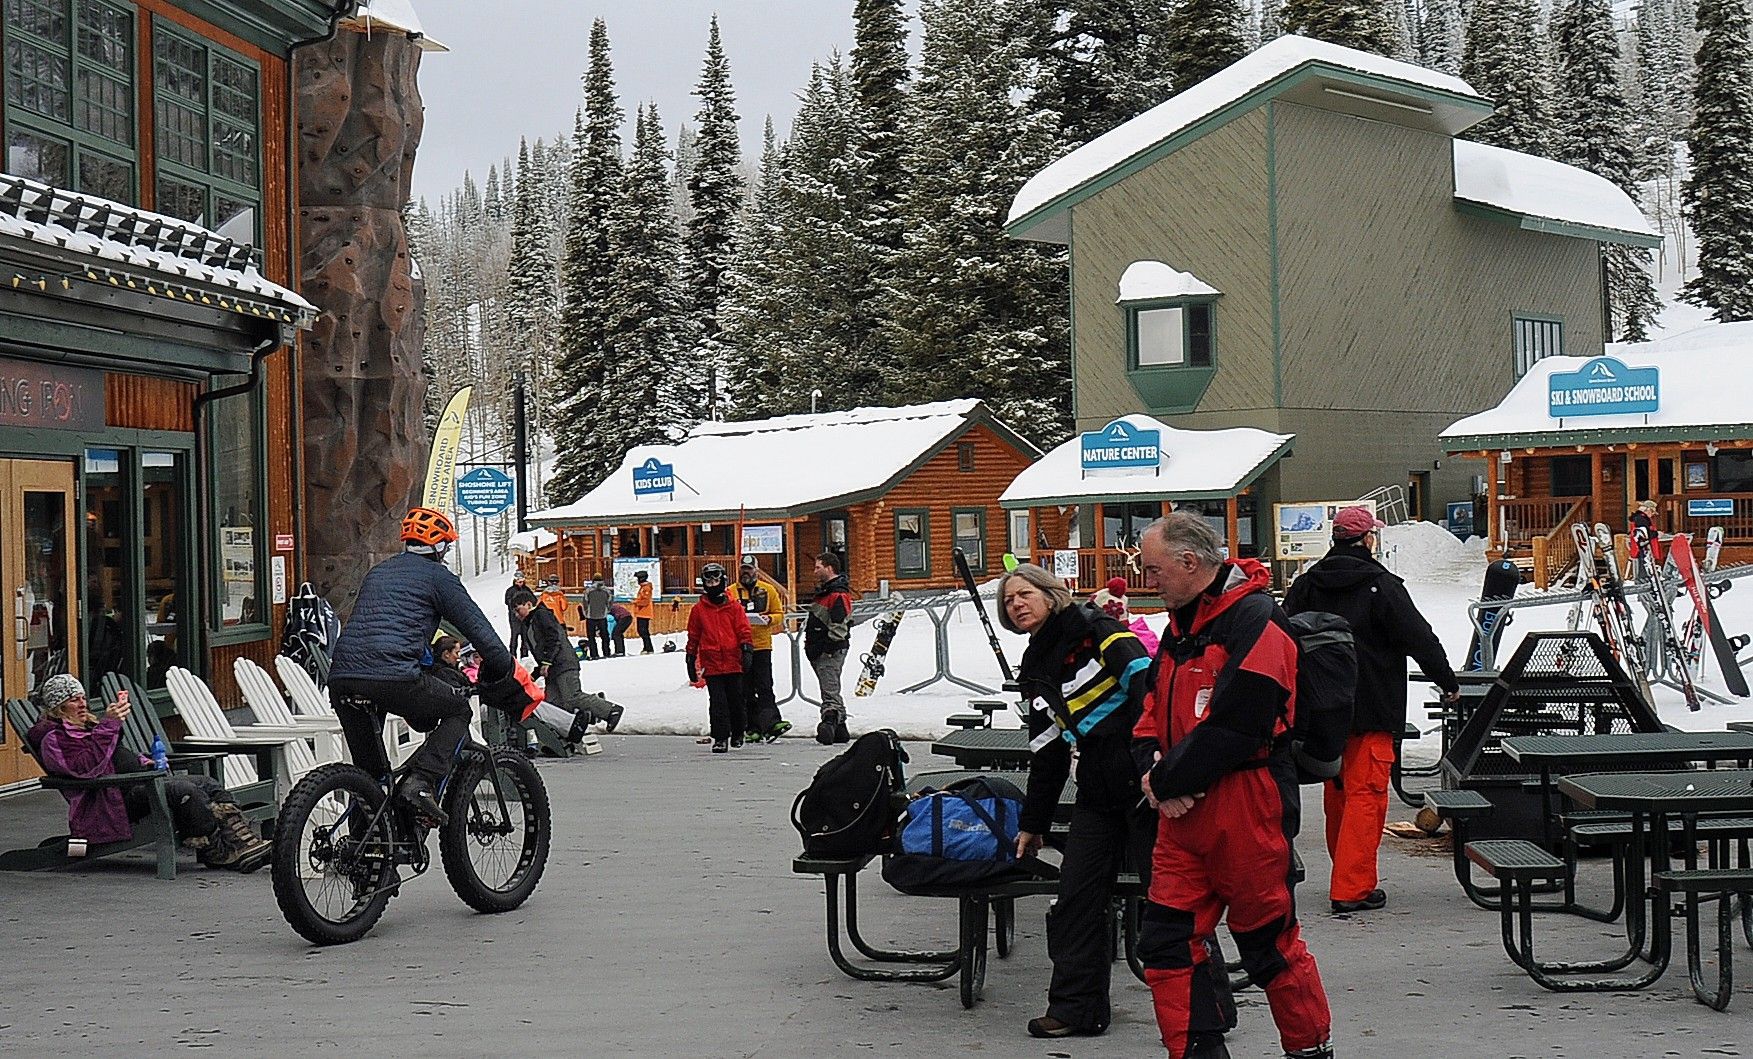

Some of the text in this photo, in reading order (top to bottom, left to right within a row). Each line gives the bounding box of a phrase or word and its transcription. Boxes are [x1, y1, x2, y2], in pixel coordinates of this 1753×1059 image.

[1551, 385, 1657, 406] SKI & SNOWBOARD SCHOOL
[445, 446, 455, 475] AREA
[1083, 446, 1158, 461] NATURE CENTER
[429, 438, 448, 504] SNOWBOARD
[635, 476, 672, 489] KIDS CLUB
